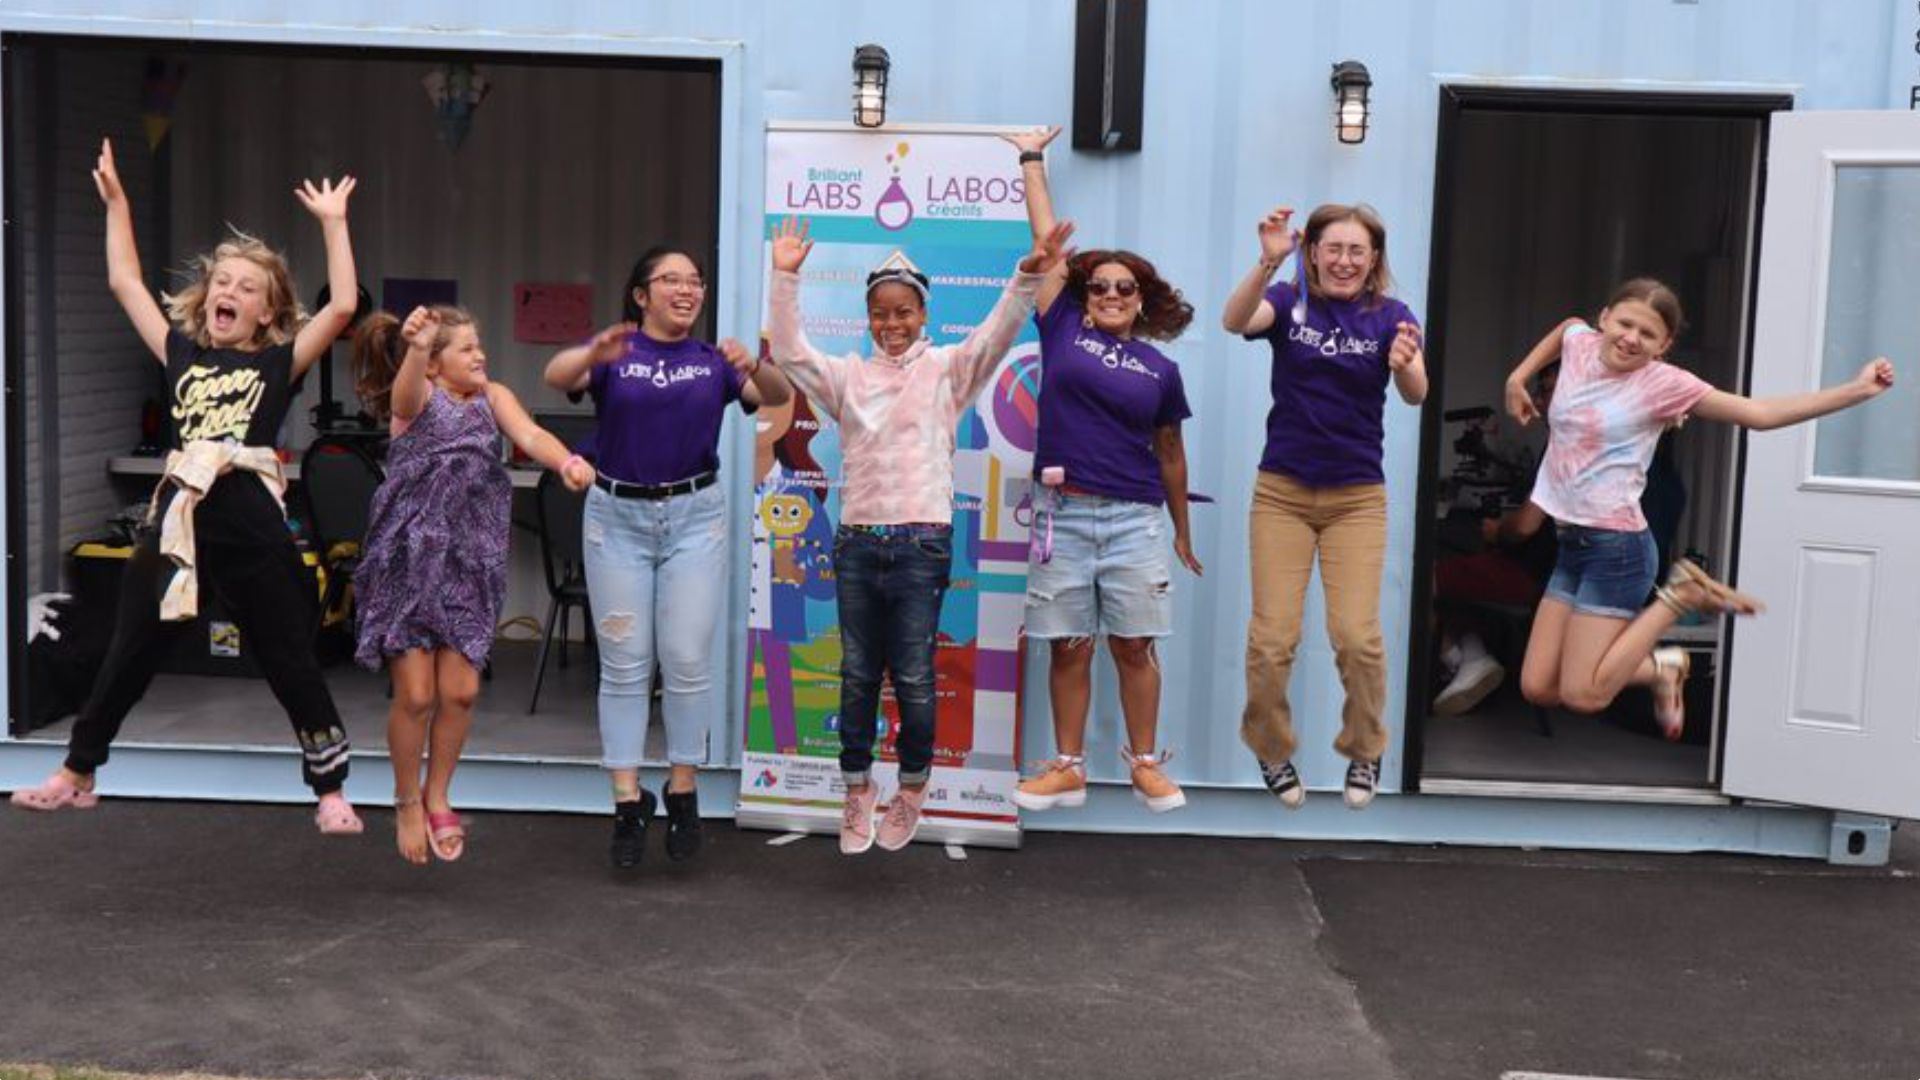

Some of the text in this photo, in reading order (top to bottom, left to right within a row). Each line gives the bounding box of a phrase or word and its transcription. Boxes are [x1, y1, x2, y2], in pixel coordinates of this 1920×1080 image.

[808, 167, 862, 182] Brilliant
[787, 176, 1026, 210] LABS LABOS
